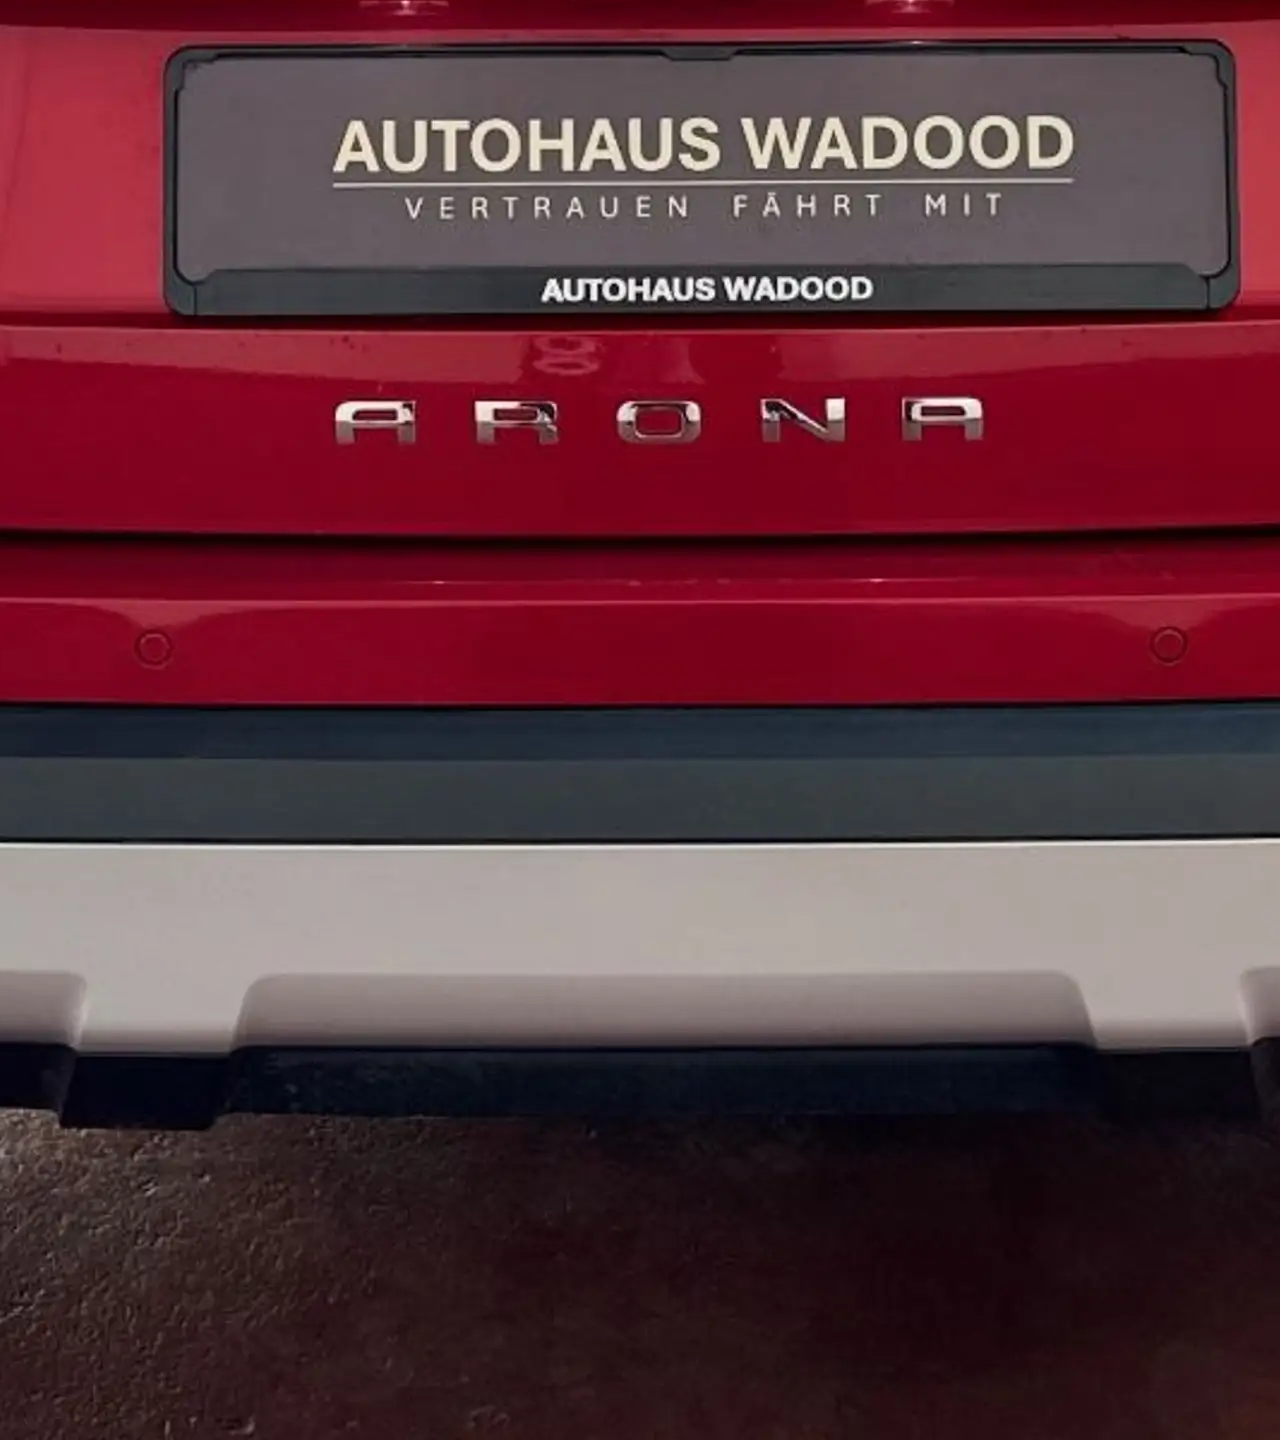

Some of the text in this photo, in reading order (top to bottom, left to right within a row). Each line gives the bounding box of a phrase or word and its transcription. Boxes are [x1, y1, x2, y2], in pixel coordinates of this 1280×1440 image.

[333, 115, 1074, 173] AUTOHAUS WADOOD
[404, 191, 1003, 220] VERTRAUEN FÄHRT MIT
[541, 275, 874, 303] AUTOHAUS WADOOD
[334, 398, 984, 445] ARONA
